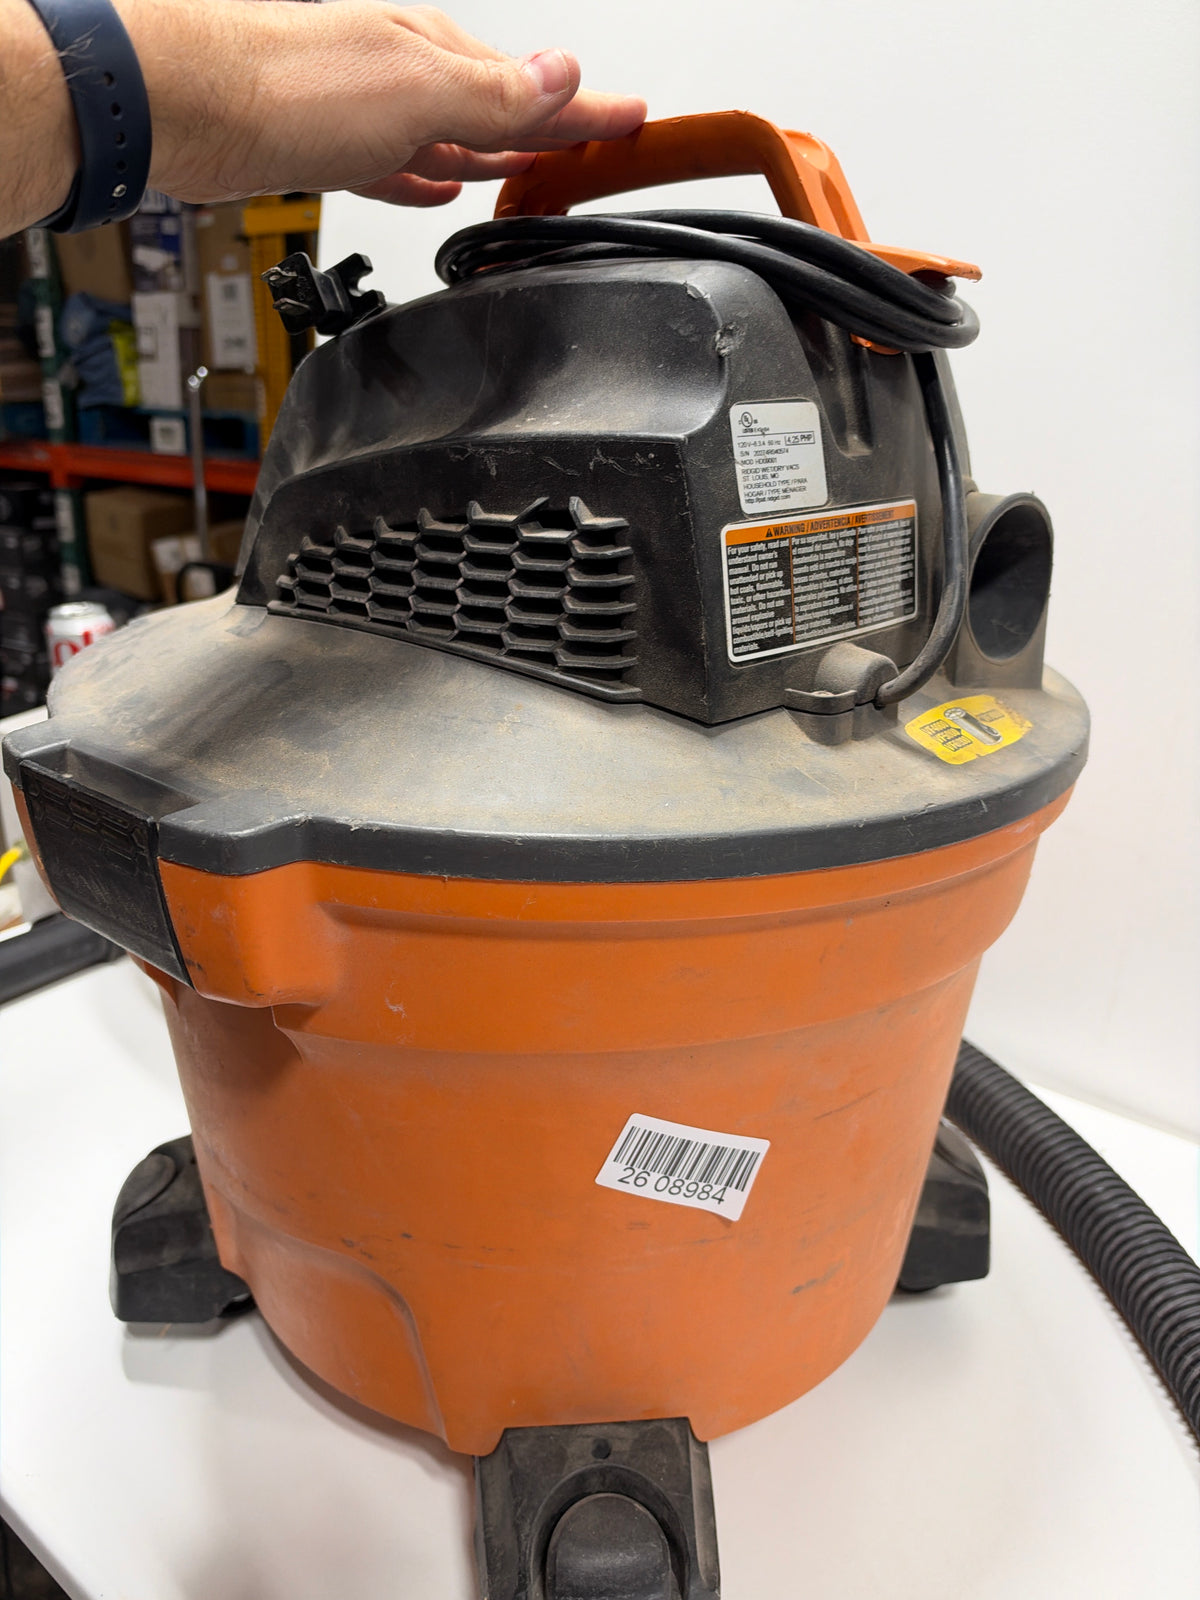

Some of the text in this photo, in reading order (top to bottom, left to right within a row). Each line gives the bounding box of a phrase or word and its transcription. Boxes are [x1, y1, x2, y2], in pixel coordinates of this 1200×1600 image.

[800, 433, 812, 442] PHP
[742, 467, 760, 475] RIDGID
[761, 465, 784, 474] WET/DRY
[743, 481, 777, 490] HOUSEHOLD
[744, 490, 763, 498] HOGAR
[768, 488, 780, 496] TYPE
[773, 523, 805, 537] WARNING
[810, 517, 851, 531] ADVERTENCIA
[728, 546, 737, 555] For
[617, 1167, 727, 1205] 26 08984
